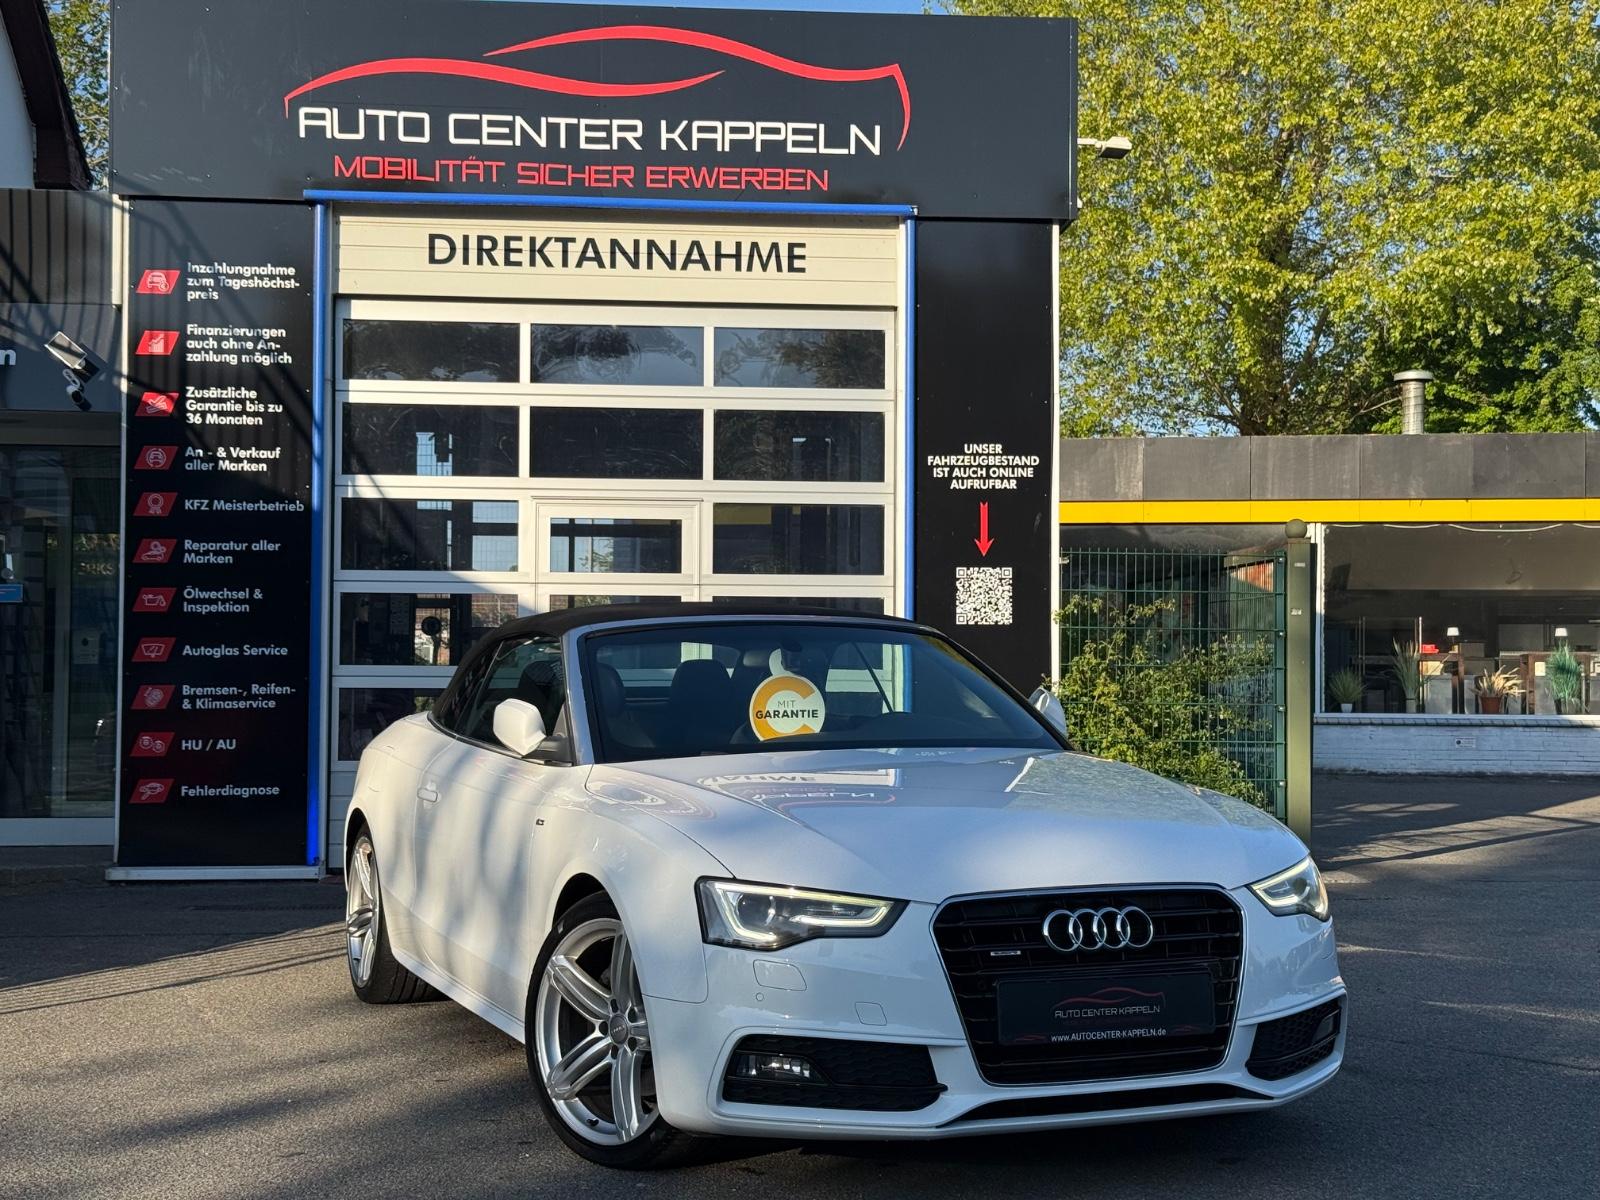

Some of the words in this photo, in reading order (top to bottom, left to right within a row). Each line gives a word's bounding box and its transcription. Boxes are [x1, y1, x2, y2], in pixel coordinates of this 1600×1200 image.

[298, 107, 431, 144] AUTO
[448, 113, 643, 151] CENTER
[660, 119, 881, 156] KAPPELN
[333, 155, 506, 184] MOBILITÄT
[517, 161, 635, 188] SICHER
[645, 166, 830, 192] ERWERBEN
[427, 233, 807, 273] DIREKTANNAHME
[187, 262, 296, 277] Inzahlungnahme
[187, 277, 214, 287] zum
[218, 275, 300, 289] Tageshöchst-
[187, 288, 219, 301] preis
[186, 324, 286, 339] Finanzierungen
[186, 338, 217, 349] auch
[221, 339, 254, 350] ohne
[257, 340, 281, 350] An-
[186, 352, 238, 365] zahlung
[241, 352, 292, 366] möglich
[185, 386, 257, 399] Zusätzliche
[185, 400, 243, 412] Garantie
[246, 401, 265, 412] bis
[267, 404, 283, 413] zu
[185, 413, 203, 425] 36
[205, 413, 263, 426] Monaten
[185, 447, 203, 458] An
[216, 447, 227, 458] &
[229, 447, 281, 459] Verkauf
[964, 443, 1003, 454] UNSER
[185, 460, 215, 471] aller
[217, 460, 267, 472] Marken
[927, 456, 1040, 467] FAHRZEUGBESTAND
[933, 467, 950, 478] IST
[952, 467, 986, 478] AUCH
[989, 467, 1034, 478] ONLINE
[949, 479, 1018, 490] AUFRUFBAR
[184, 500, 209, 511] KFZ
[212, 500, 305, 512] Meisterbetrieb
[184, 540, 248, 552] Reparatur
[251, 540, 281, 551] aller
[183, 553, 233, 564] Marken
[183, 586, 250, 599] Ölwechsel
[253, 588, 263, 599] &
[183, 602, 250, 615] Inspektion
[182, 645, 240, 658] Autoglas
[243, 645, 288, 656] Service
[182, 685, 247, 697] Bremsen-,
[251, 683, 296, 695] Reifen-
[182, 699, 192, 709] &
[195, 698, 276, 709] Klimaservice
[777, 700, 797, 709] MIT
[755, 709, 819, 720] GARANTIE
[181, 740, 202, 750] HU
[216, 739, 236, 750] AU
[181, 785, 280, 798] Fehlerdiagnose
[1054, 1009, 1081, 1018] AUTO
[1081, 1007, 1118, 1017] CENTER
[1119, 1005, 1161, 1015] KAPPELN
[1051, 1028, 1167, 1042] www.AUTOCENTER-KAPPELN.de
